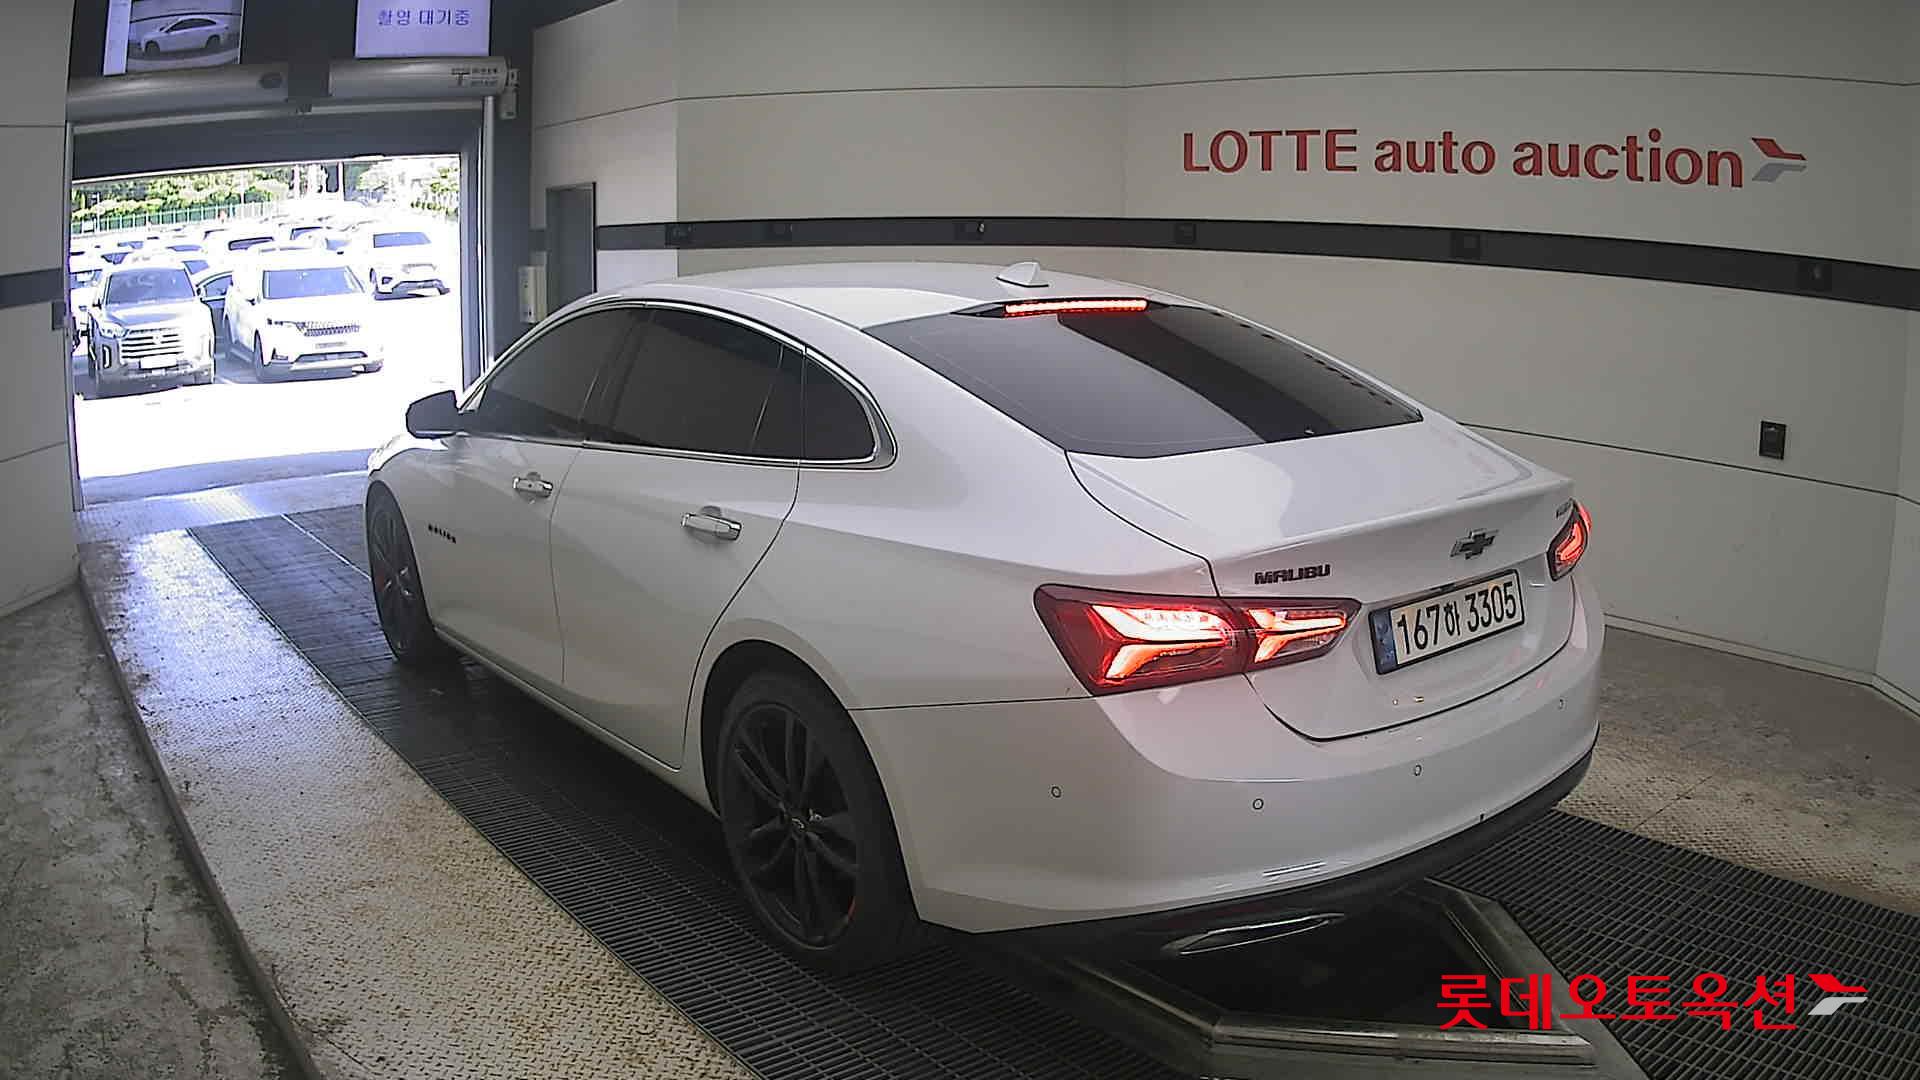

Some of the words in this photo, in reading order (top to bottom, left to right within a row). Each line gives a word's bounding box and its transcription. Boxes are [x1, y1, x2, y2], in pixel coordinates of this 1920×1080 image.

[419, 9, 470, 26] 대기중
[1184, 129, 1357, 173] LOTTE
[1374, 131, 1496, 174] auto
[1513, 128, 1743, 188] auction
[1254, 564, 1331, 584] MALIBU
[1397, 600, 1461, 655] 167하
[1465, 581, 1517, 632] 3305
